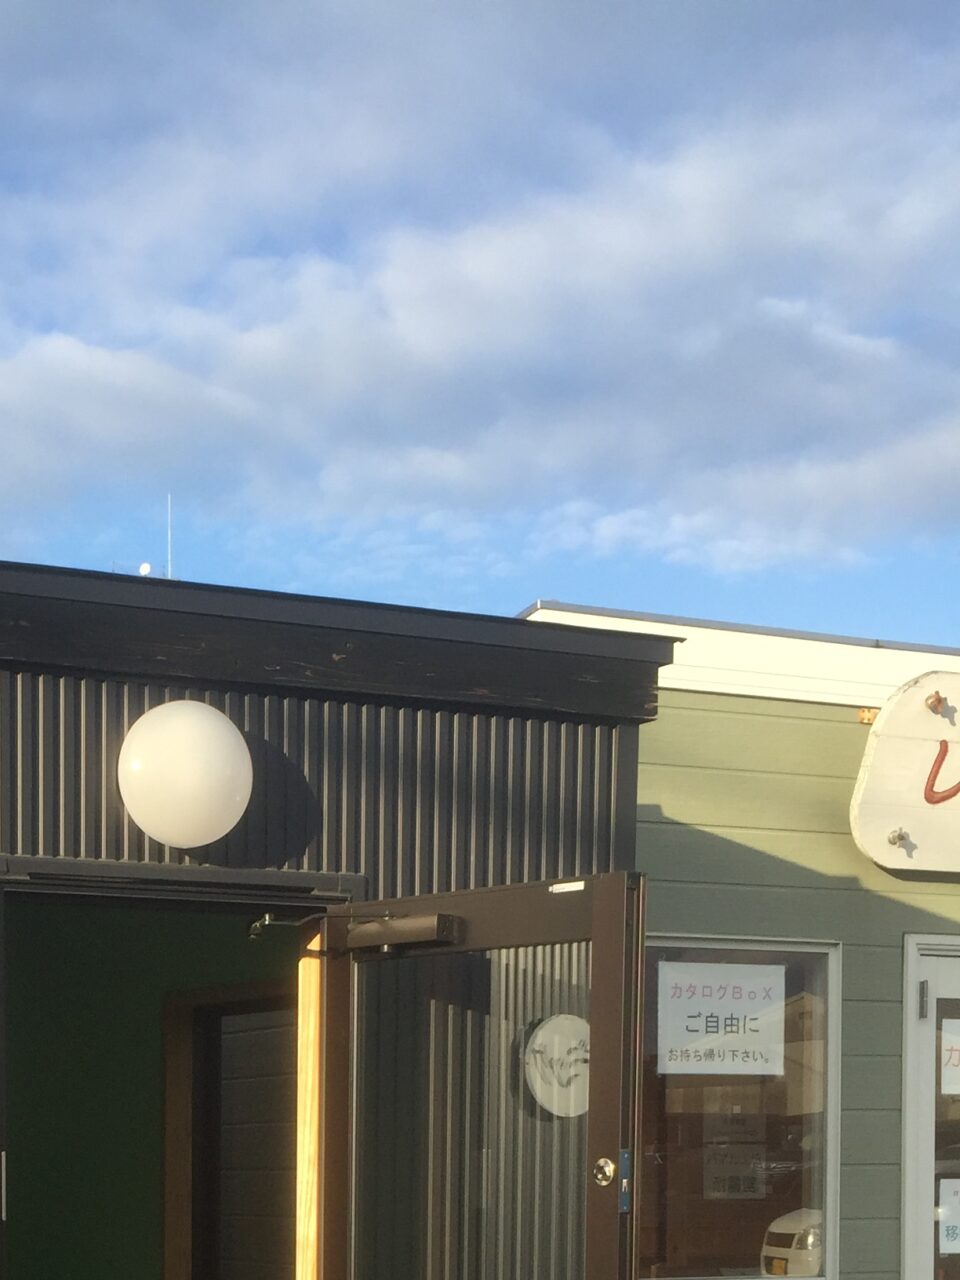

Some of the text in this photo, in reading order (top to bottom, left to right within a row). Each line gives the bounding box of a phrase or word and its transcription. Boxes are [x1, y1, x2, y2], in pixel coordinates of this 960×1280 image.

[685, 1011, 760, 1035] ご自由に
[668, 1047, 769, 1064] お持ち帰り下さい。
